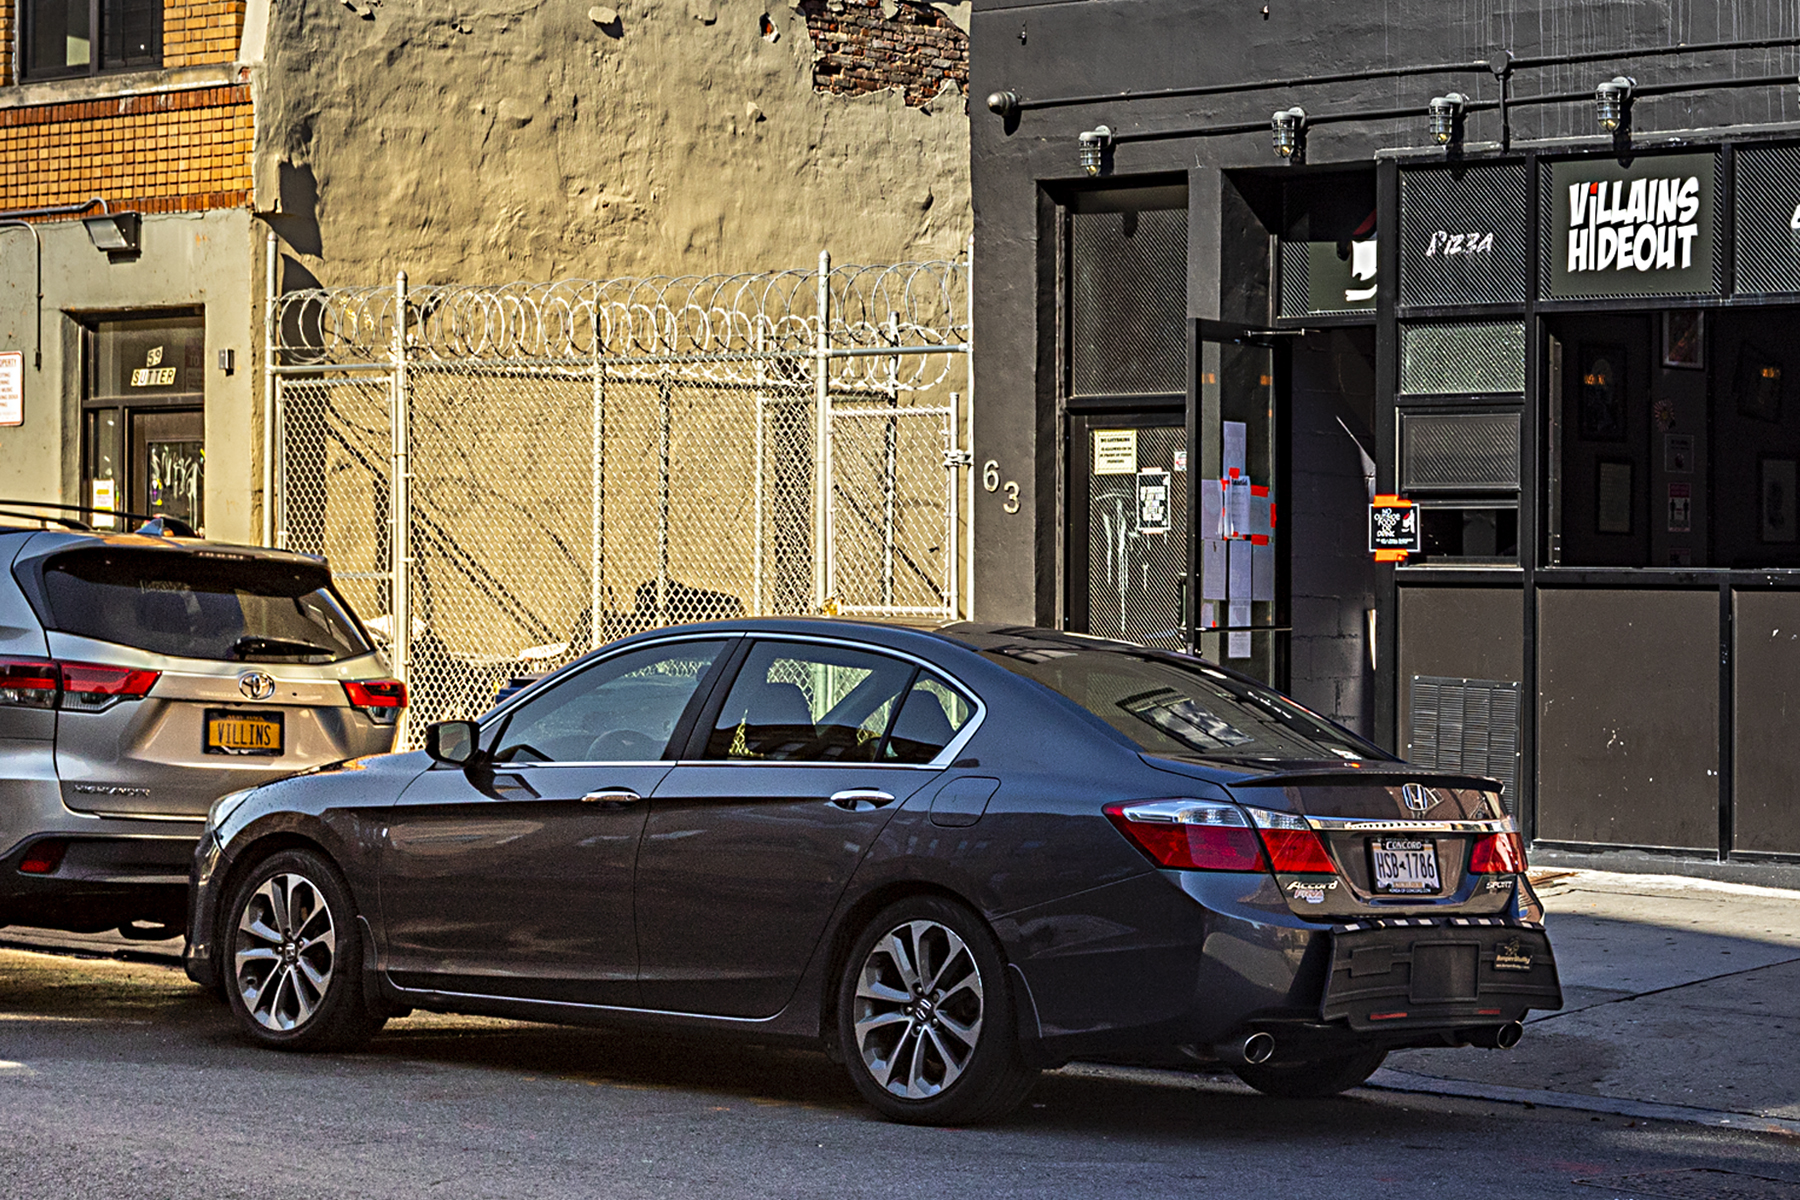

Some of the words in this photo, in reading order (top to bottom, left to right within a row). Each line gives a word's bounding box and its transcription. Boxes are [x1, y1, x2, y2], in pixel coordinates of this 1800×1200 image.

[1568, 176, 1699, 227] VILLAINS
[1426, 230, 1494, 256] PIZZA
[1567, 222, 1699, 273] HIDEOUT
[147, 349, 162, 366] 59
[131, 369, 175, 385] SUTTER
[983, 460, 1020, 514] 63
[1382, 508, 1392, 517] NO
[218, 722, 271, 746] VILLINS
[1386, 841, 1423, 850] CONCORD
[1376, 852, 1399, 879] HSB
[1405, 852, 1435, 879] 1786
[1286, 879, 1339, 891] Accord
[1486, 880, 1513, 890] SPORT
